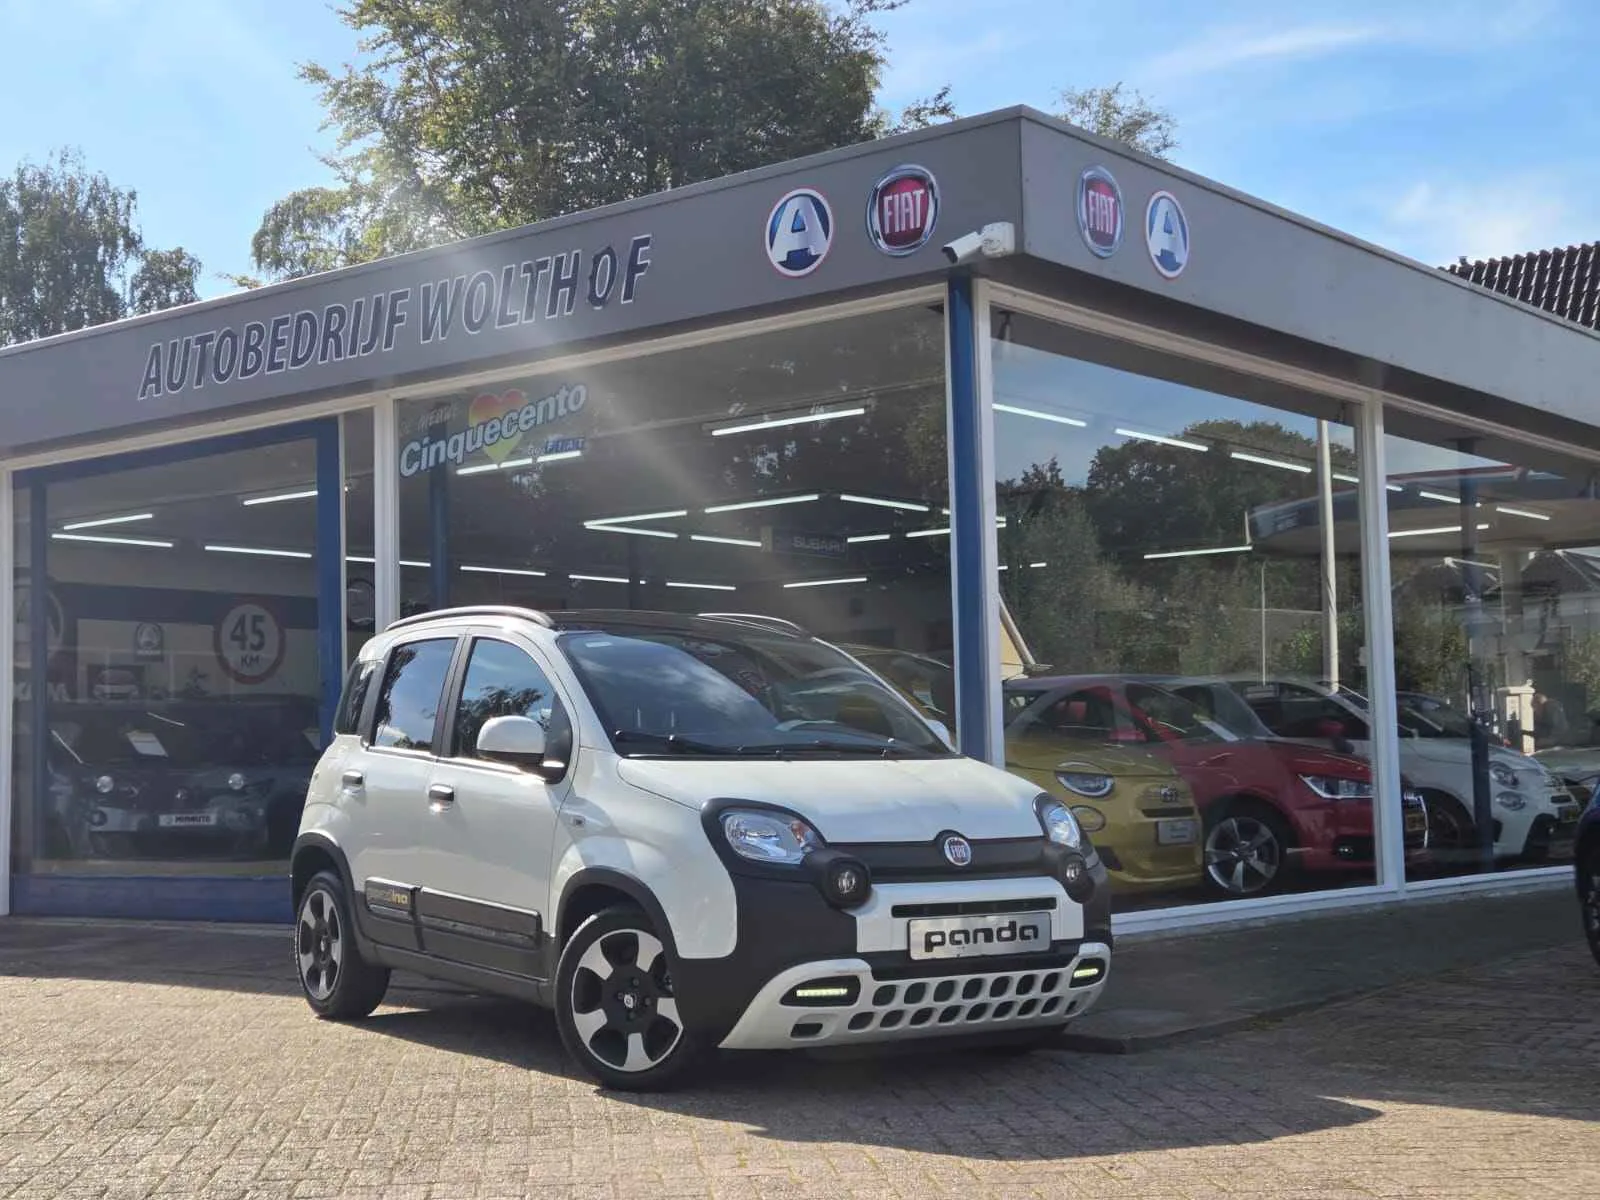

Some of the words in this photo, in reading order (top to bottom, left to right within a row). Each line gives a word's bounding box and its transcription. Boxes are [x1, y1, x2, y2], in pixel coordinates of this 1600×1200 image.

[883, 188, 925, 235] FIAT
[1087, 189, 1115, 235] FIAT
[138, 289, 409, 400] AUTOBEDRIJF
[400, 383, 588, 478] Cinquecento
[230, 614, 266, 651] 45
[241, 654, 260, 667] KM
[924, 920, 1039, 952] panda
